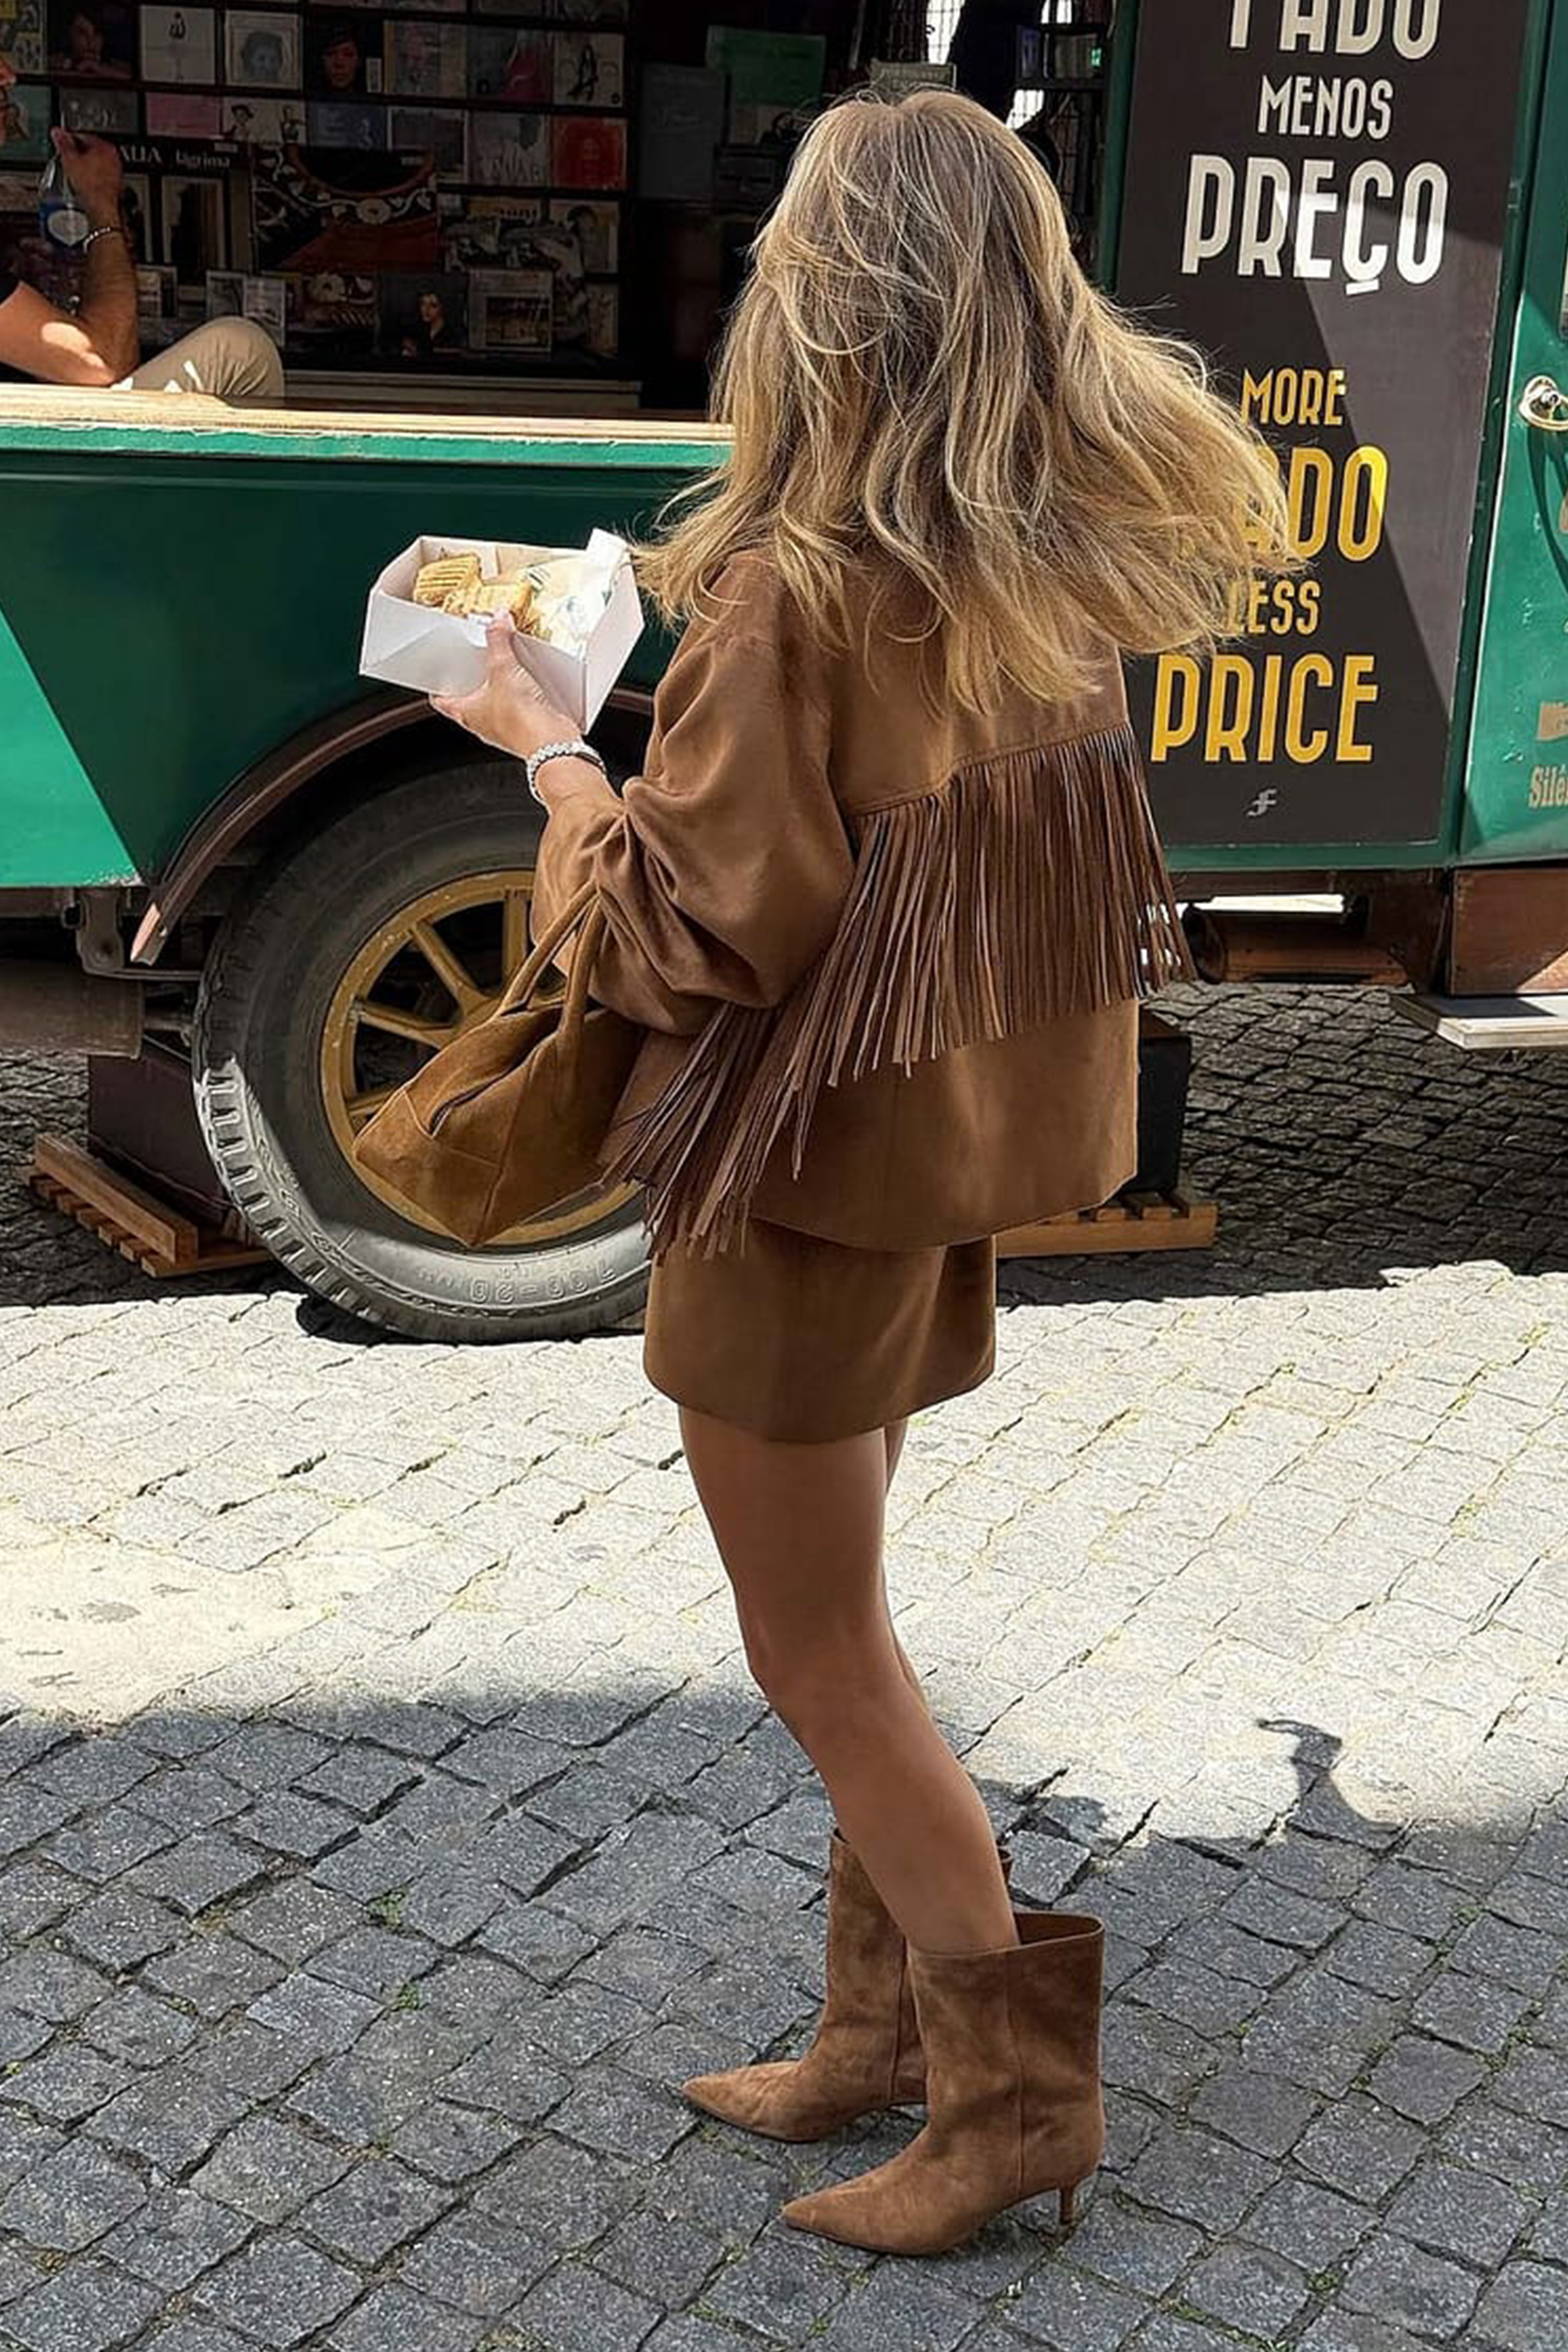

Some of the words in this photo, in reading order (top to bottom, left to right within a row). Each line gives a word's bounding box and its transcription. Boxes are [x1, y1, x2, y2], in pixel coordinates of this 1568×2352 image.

[1258, 74, 1394, 139] MENOS
[1181, 154, 1448, 296] PREÇO
[1240, 368, 1346, 425] MORE
[1261, 446, 1388, 562] DO
[1151, 654, 1379, 763] PRICE
